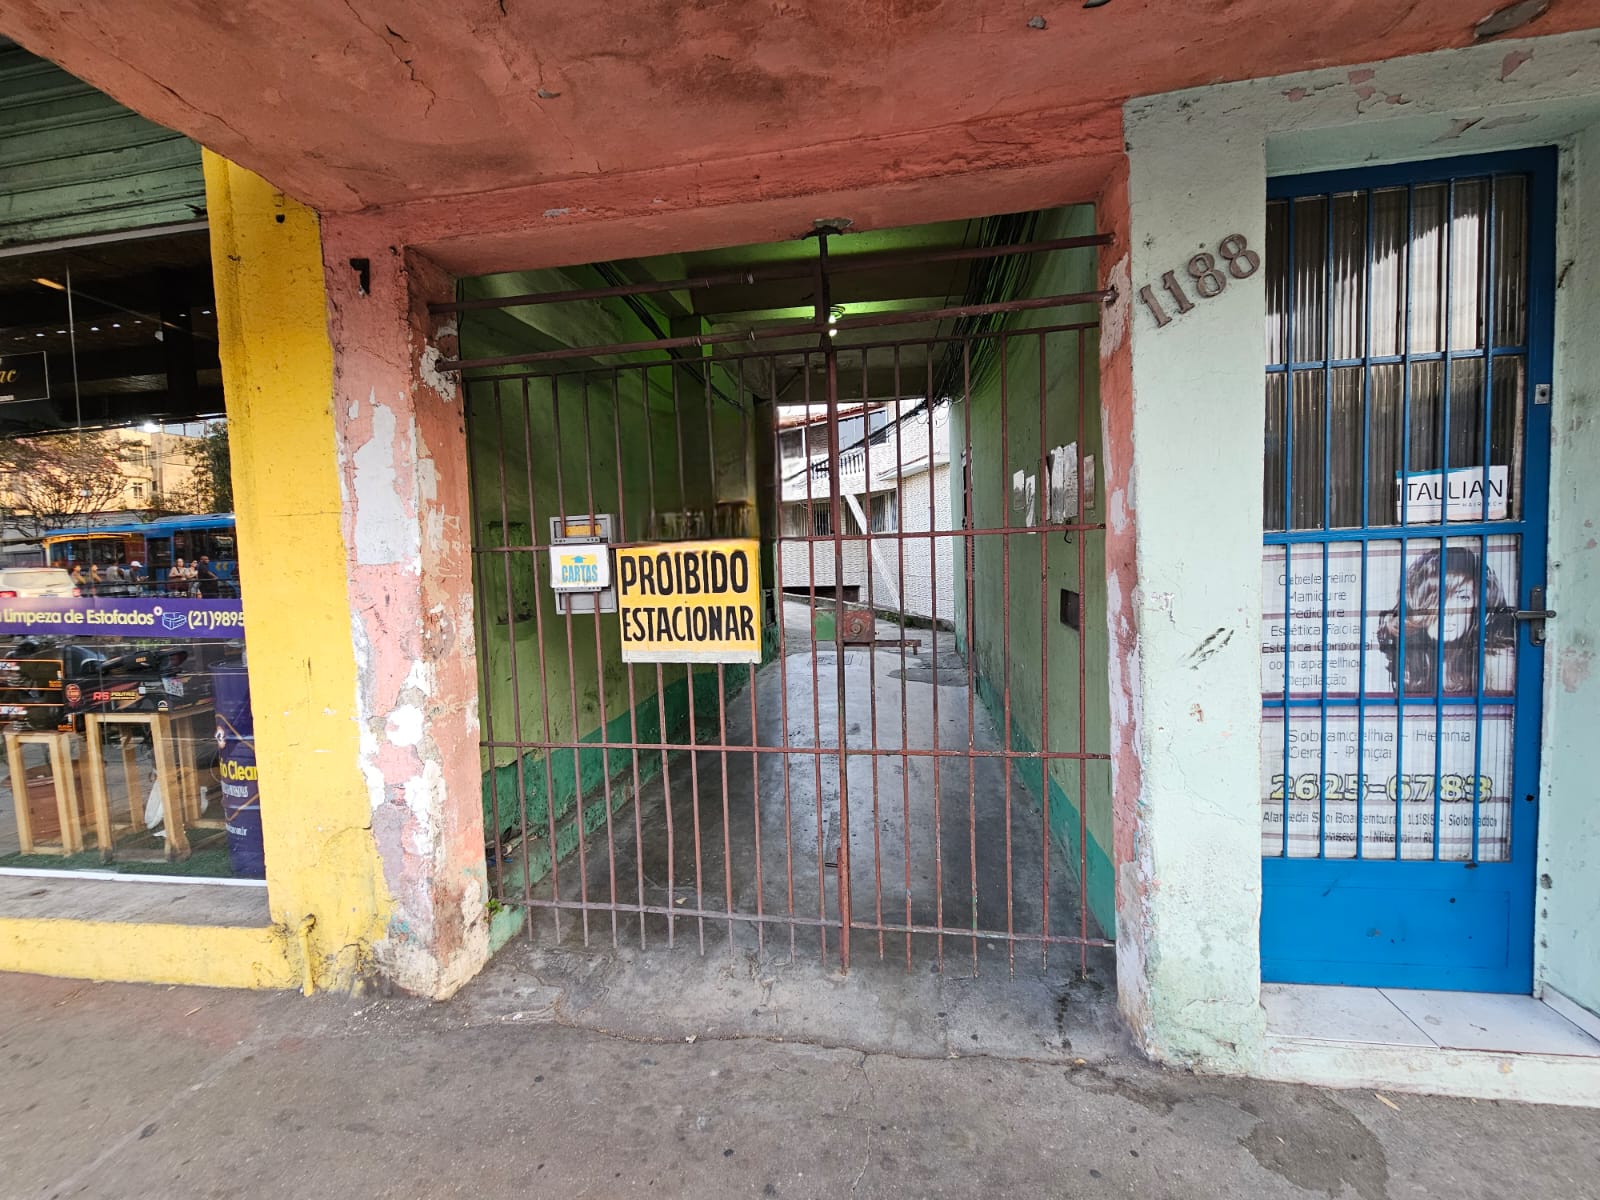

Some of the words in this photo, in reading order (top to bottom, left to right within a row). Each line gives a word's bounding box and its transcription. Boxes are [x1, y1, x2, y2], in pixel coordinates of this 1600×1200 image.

[1140, 233, 1260, 328] 1188
[561, 564, 598, 583] CARTAS
[620, 549, 748, 595] PROIBIDO
[4, 608, 61, 626] Limpeza
[64, 609, 84, 623] de
[621, 605, 755, 642] ESTACIONAR
[1271, 624, 1320, 637] Esética
[1327, 623, 1360, 635] Facia
[1270, 774, 1494, 802] 2625-6783
[1312, 811, 1333, 823] So
